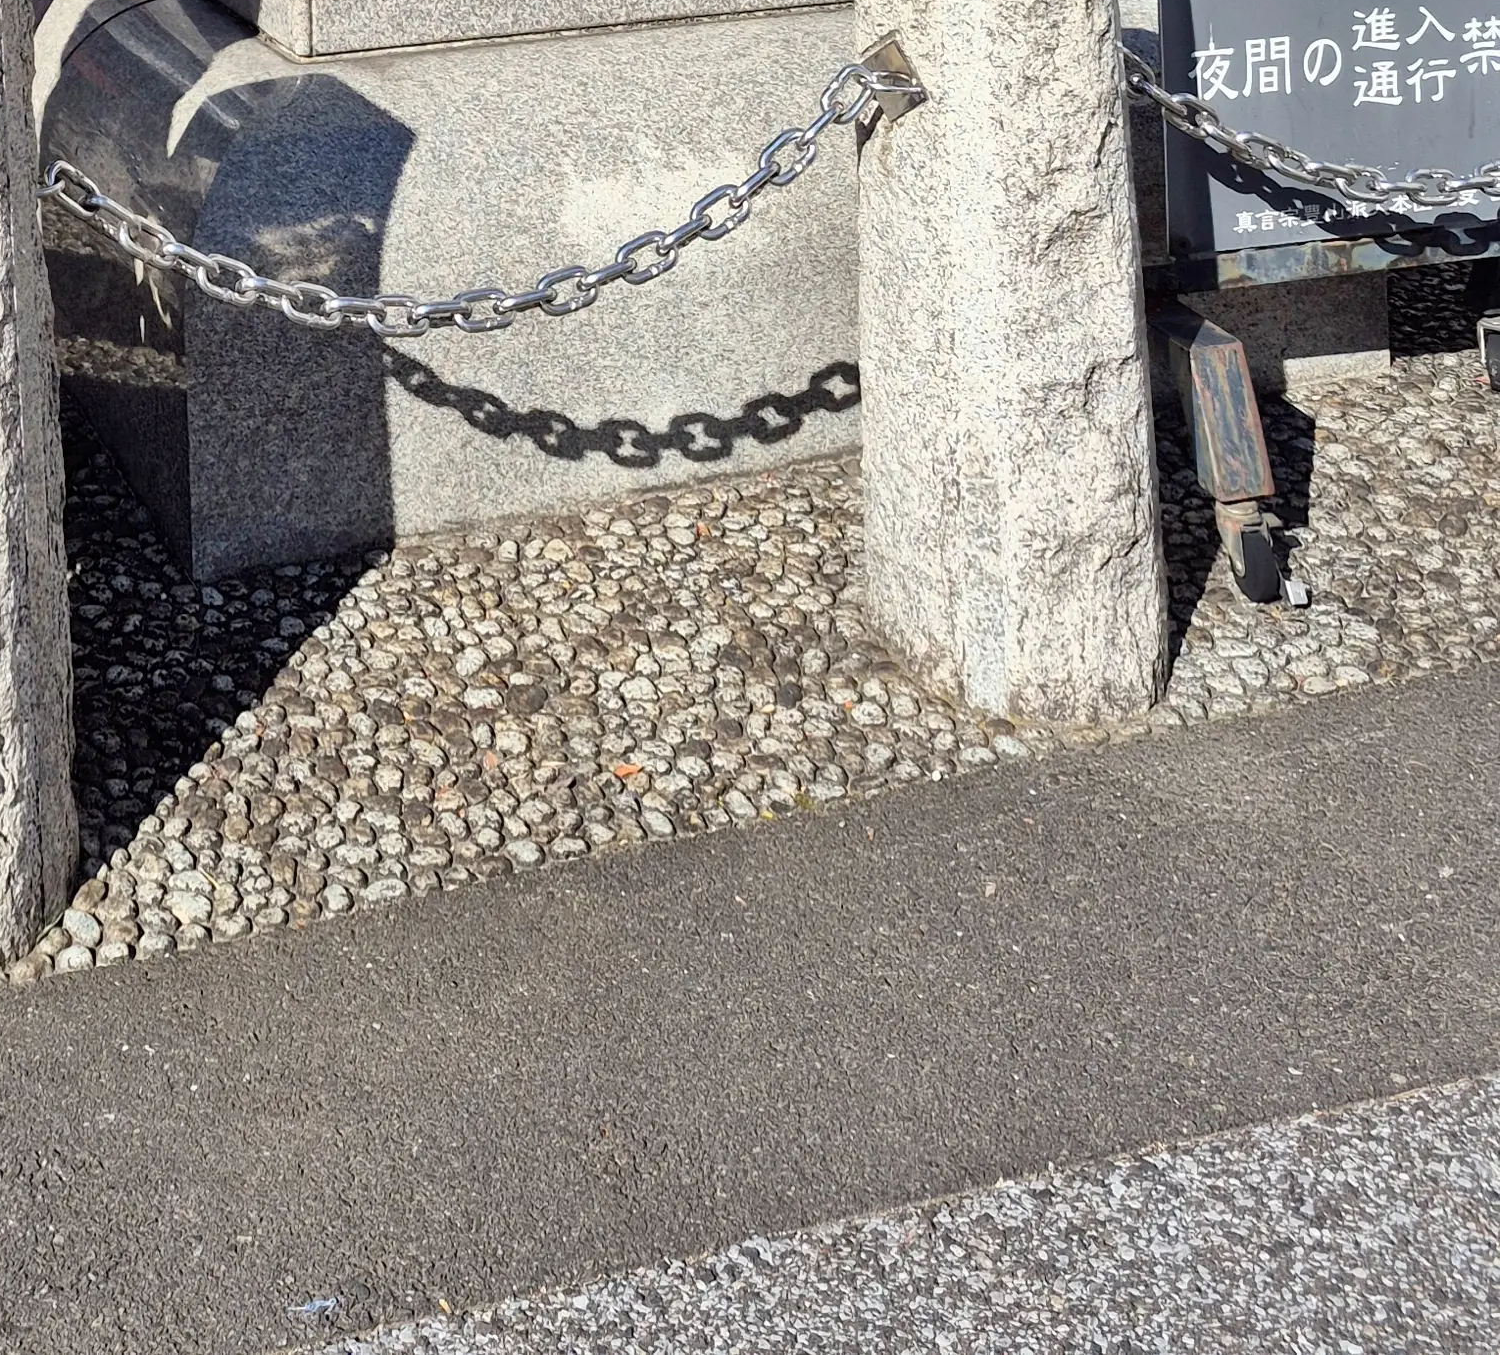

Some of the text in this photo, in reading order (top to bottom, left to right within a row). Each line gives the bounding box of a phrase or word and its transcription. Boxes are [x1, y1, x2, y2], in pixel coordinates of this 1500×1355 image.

[1188, 32, 1342, 102] 夜間の
[1351, 6, 1456, 52] 進入
[1351, 57, 1457, 108] 通行
